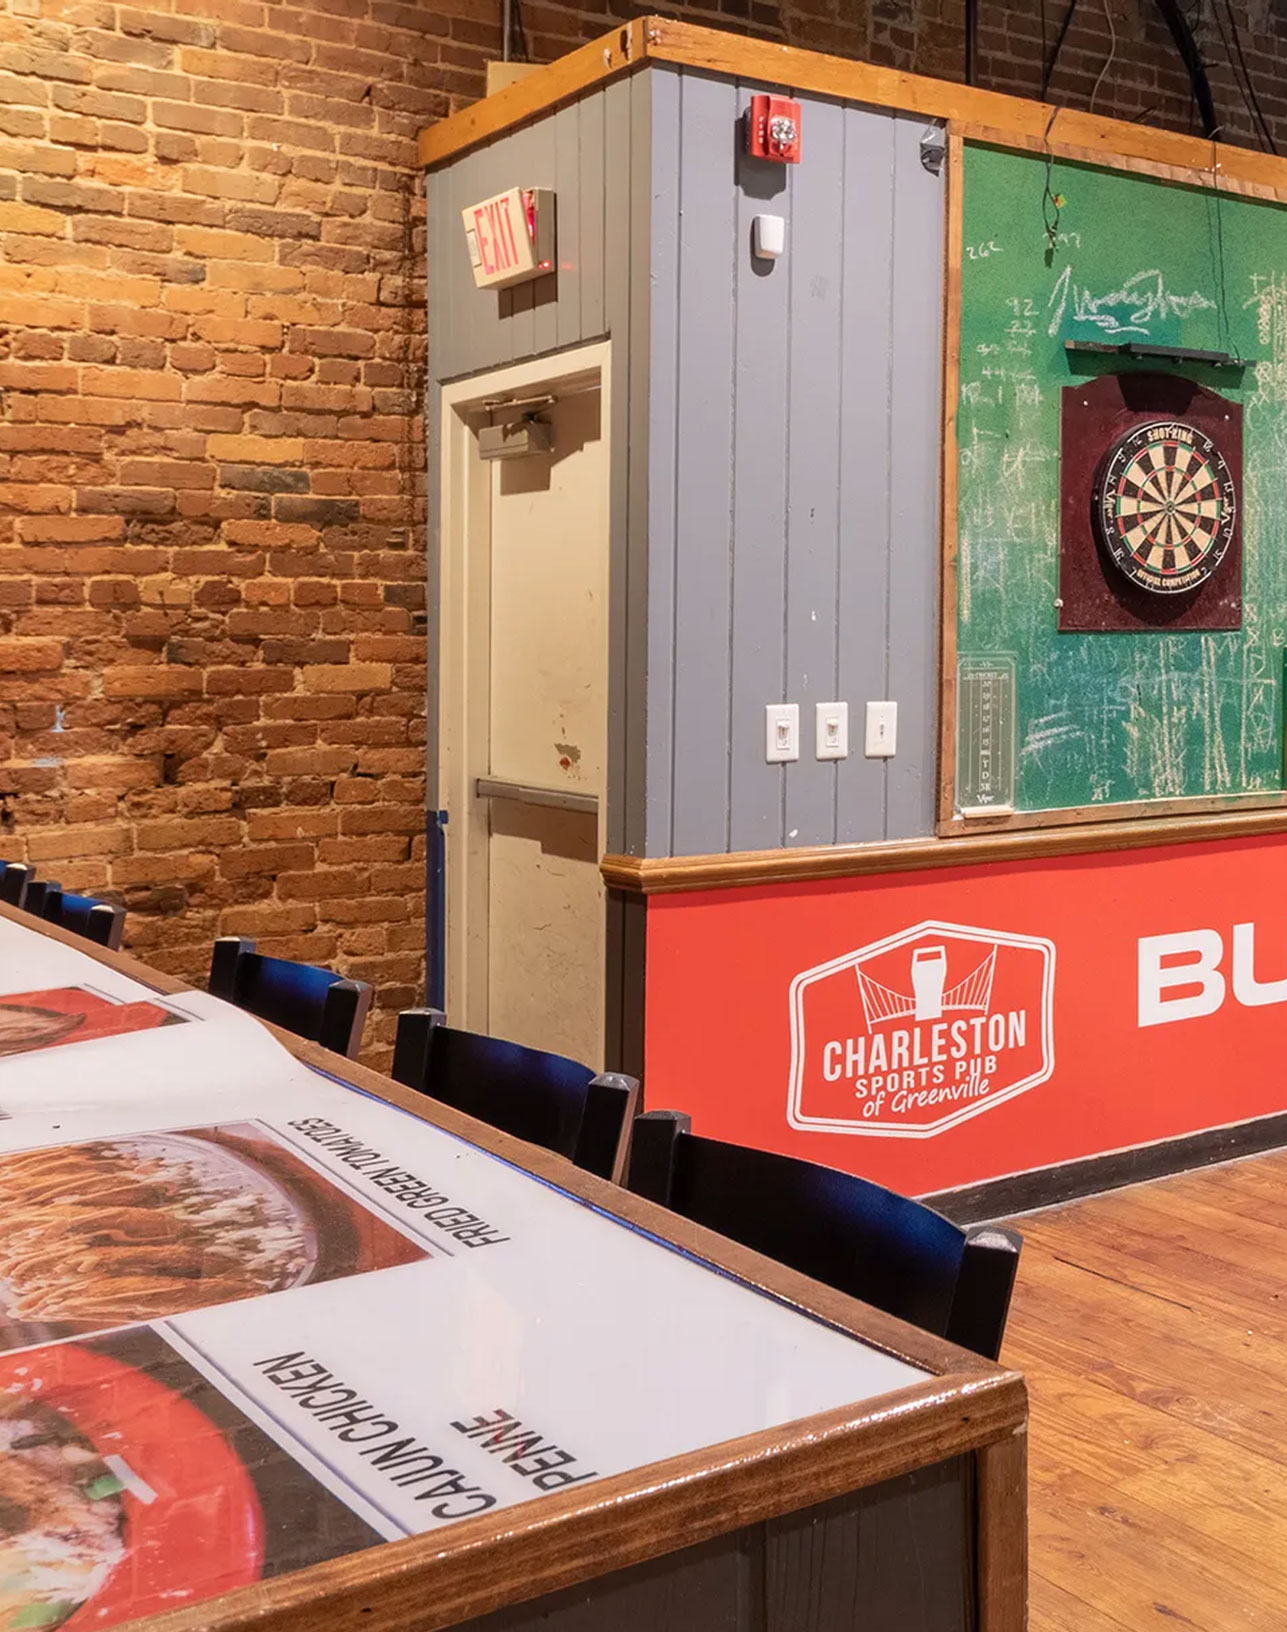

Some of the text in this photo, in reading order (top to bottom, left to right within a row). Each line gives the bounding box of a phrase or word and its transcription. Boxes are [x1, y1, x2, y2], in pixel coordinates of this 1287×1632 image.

[473, 197, 519, 275] EXIT
[822, 1009, 1027, 1082] CHARLESTON
[855, 1054, 998, 1099] SPORTS PUB
[862, 1075, 990, 1118] of Greenville
[287, 1117, 512, 1249] FRIED GREEN TOMATOES
[252, 1350, 498, 1520] CAJUN CHICKEN
[448, 1408, 600, 1492] PENNE
